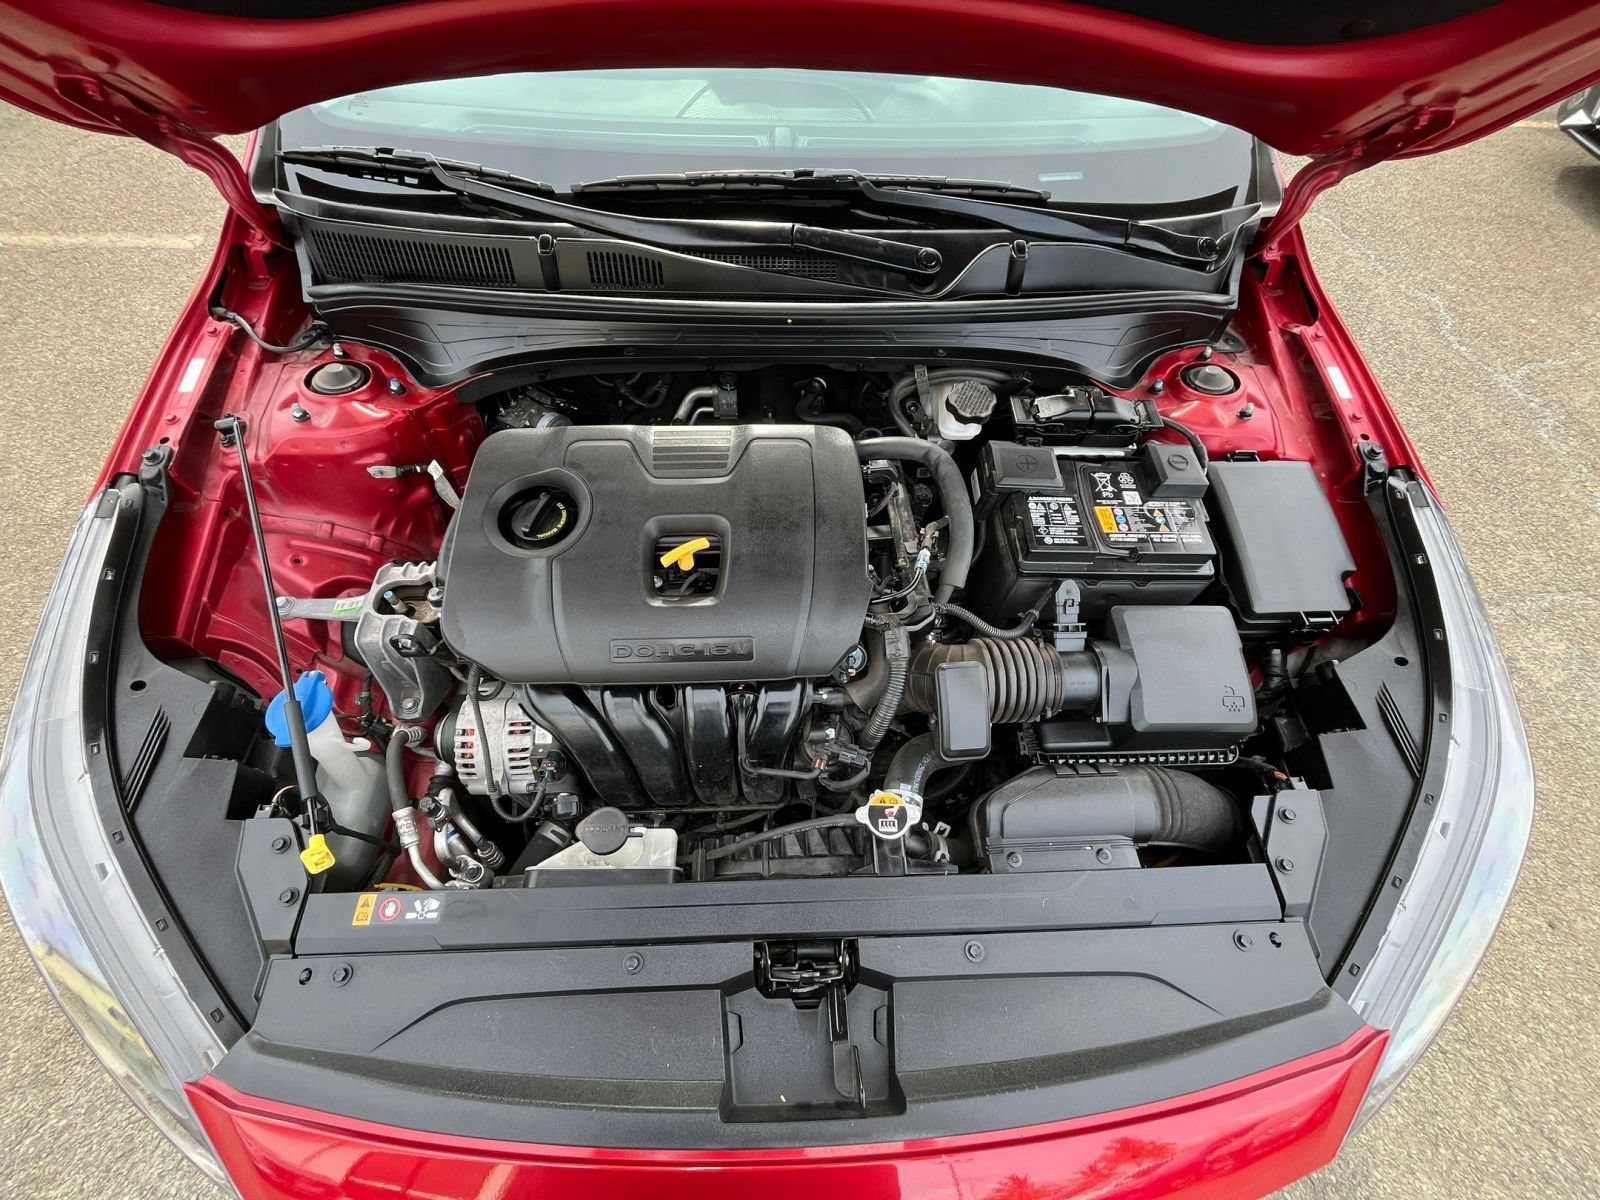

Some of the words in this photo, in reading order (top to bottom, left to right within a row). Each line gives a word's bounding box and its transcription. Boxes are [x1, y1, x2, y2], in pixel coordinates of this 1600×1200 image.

[612, 644, 696, 658] DOHC
[703, 642, 749, 656] 16V
[584, 824, 627, 833] COOLANT
